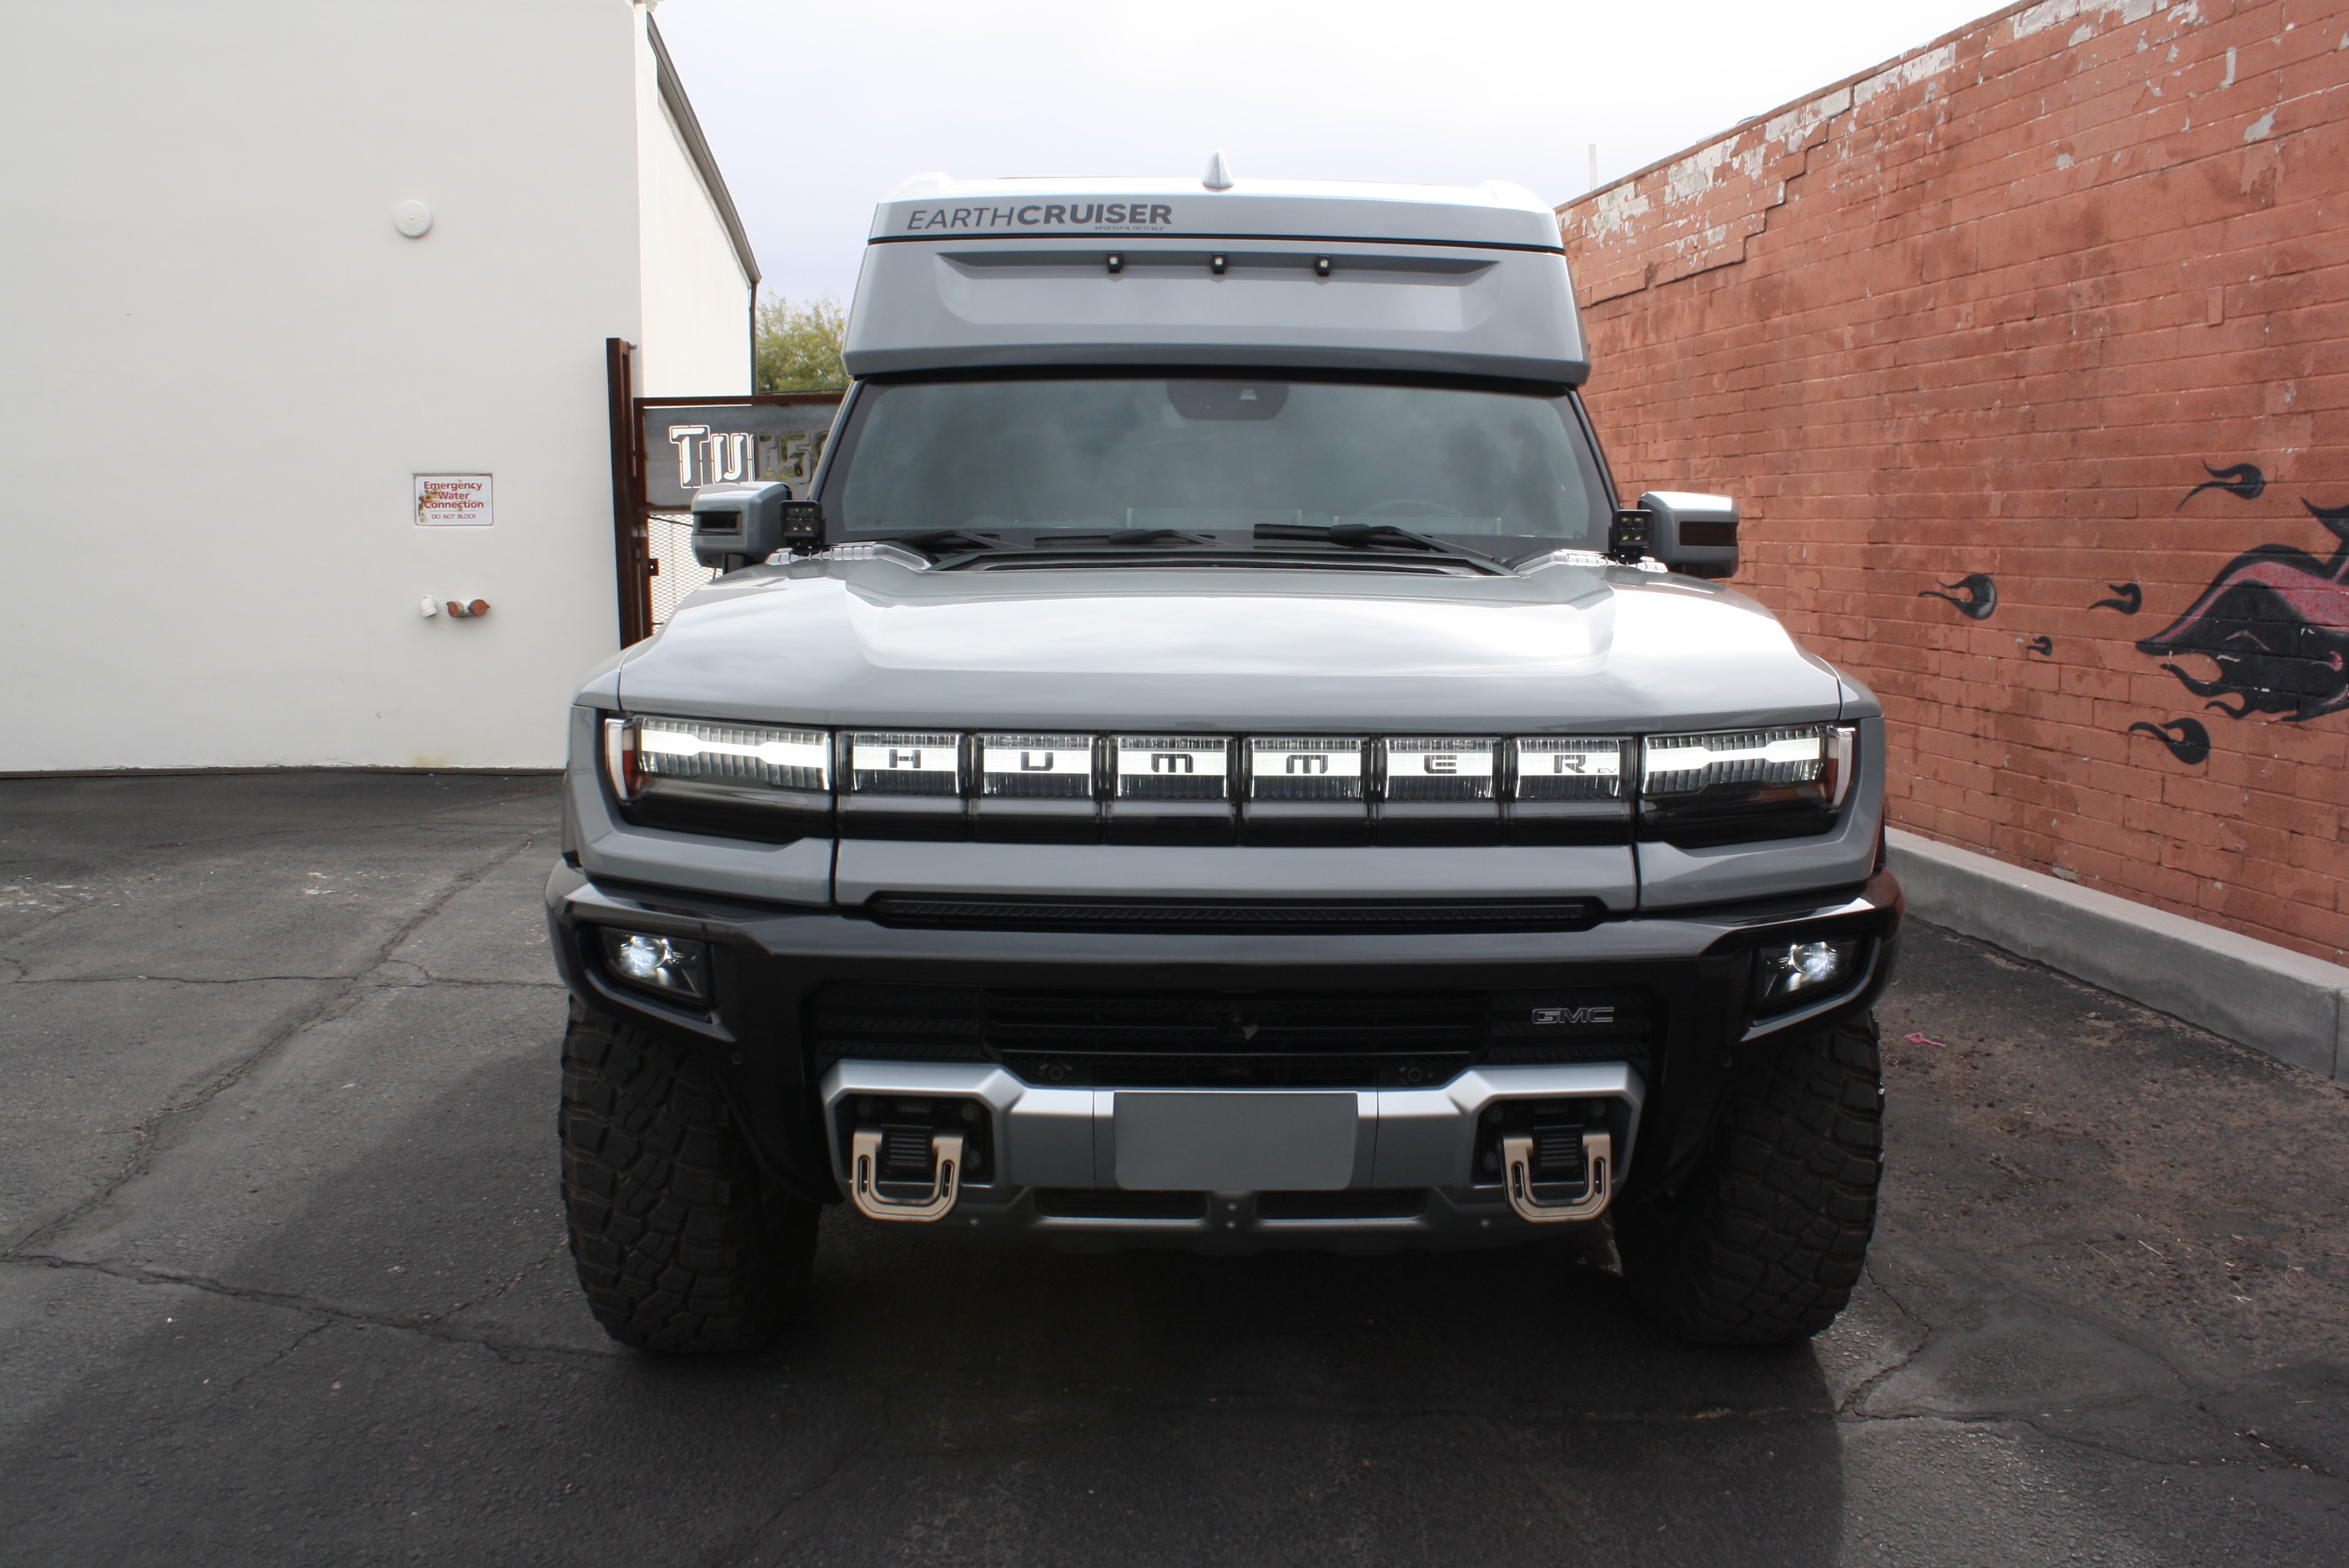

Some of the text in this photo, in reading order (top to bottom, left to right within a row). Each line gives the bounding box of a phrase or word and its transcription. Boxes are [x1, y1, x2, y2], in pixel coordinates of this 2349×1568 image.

[907, 204, 1172, 230] EARTHCRUISER
[424, 481, 483, 491] Emergency
[438, 491, 470, 500] Water
[424, 500, 484, 509] Connection
[1532, 1007, 1615, 1024] GMC
